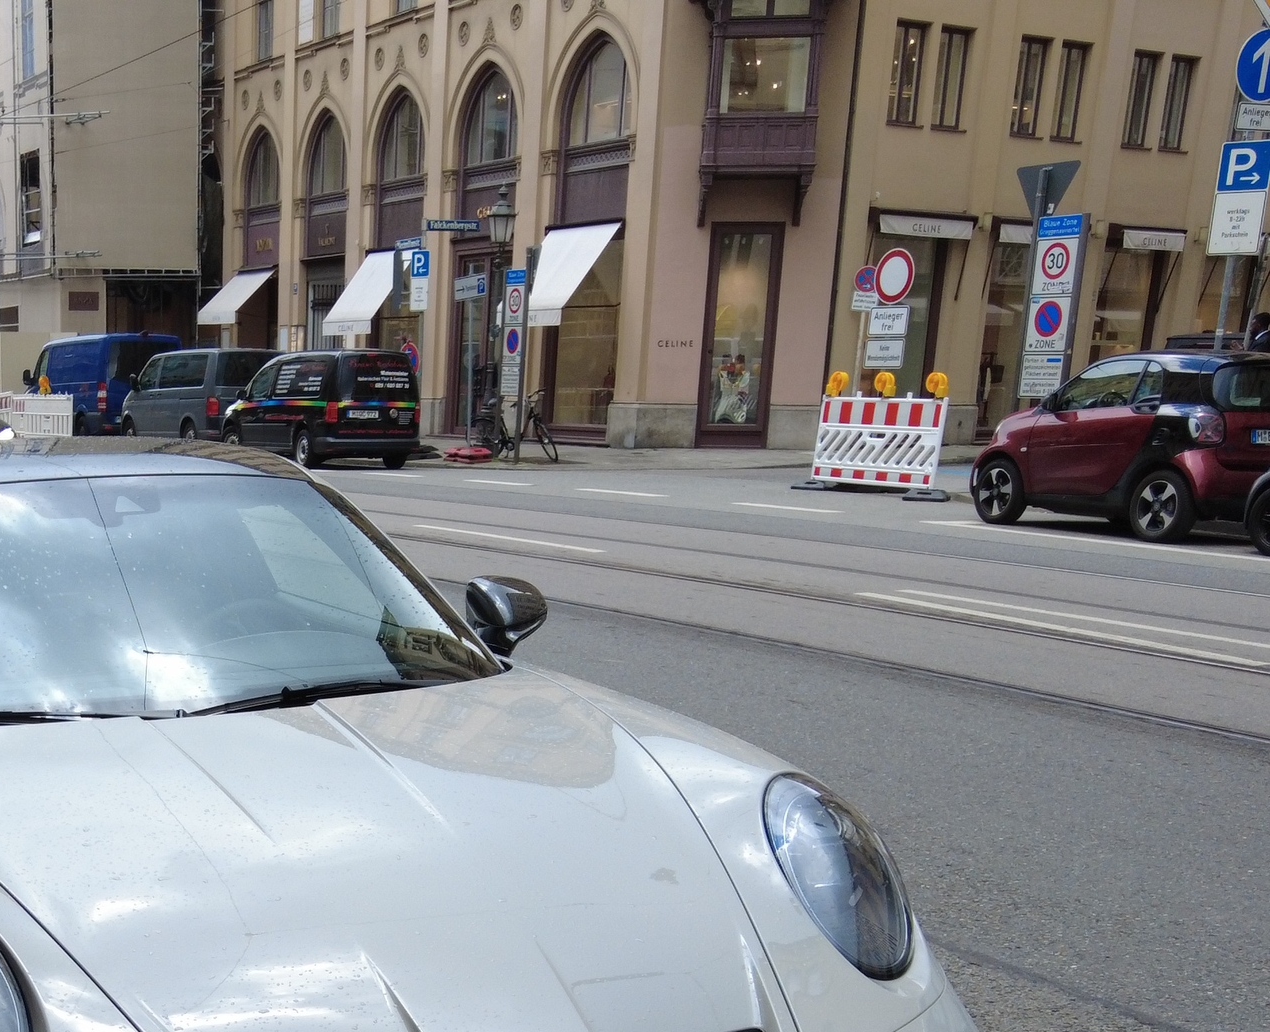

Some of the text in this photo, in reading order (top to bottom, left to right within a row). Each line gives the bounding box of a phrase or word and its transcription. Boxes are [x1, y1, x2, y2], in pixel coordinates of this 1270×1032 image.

[1249, 118, 1262, 127] frei
[1225, 148, 1257, 186] P
[1043, 218, 1078, 228] Blaue Zone
[912, 223, 942, 234] CELINE
[1142, 237, 1168, 247] CELINE
[413, 253, 425, 274] P
[1047, 252, 1065, 270] 30
[873, 311, 904, 322] Anlieger
[881, 322, 894, 331] frei
[657, 340, 694, 348] CELINE
[1034, 340, 1056, 349] ZONE
